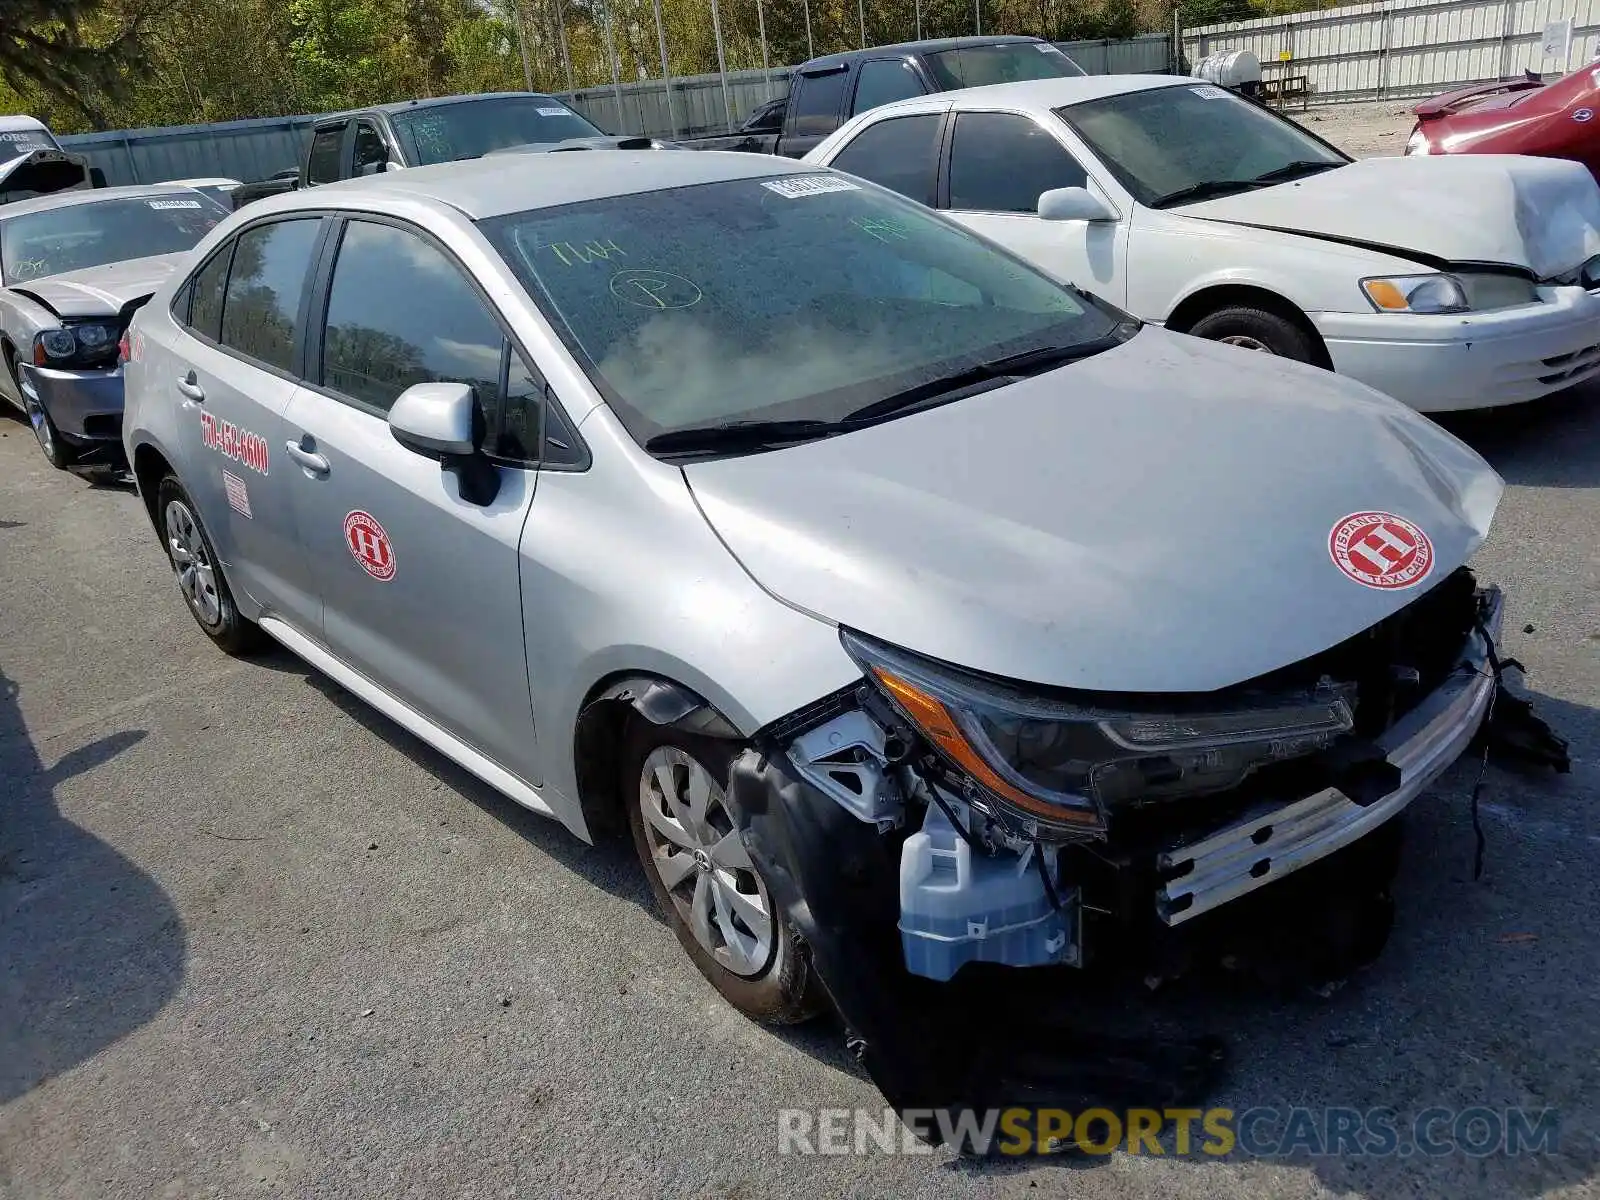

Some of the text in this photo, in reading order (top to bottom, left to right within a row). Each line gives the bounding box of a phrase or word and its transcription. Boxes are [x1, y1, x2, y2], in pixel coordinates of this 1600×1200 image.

[201, 409, 269, 476] 770-458-6600
[354, 526, 386, 566] H
[1337, 515, 1393, 561] HISPANOS
[1348, 523, 1417, 575] H
[1371, 573, 1406, 584] TAXI
